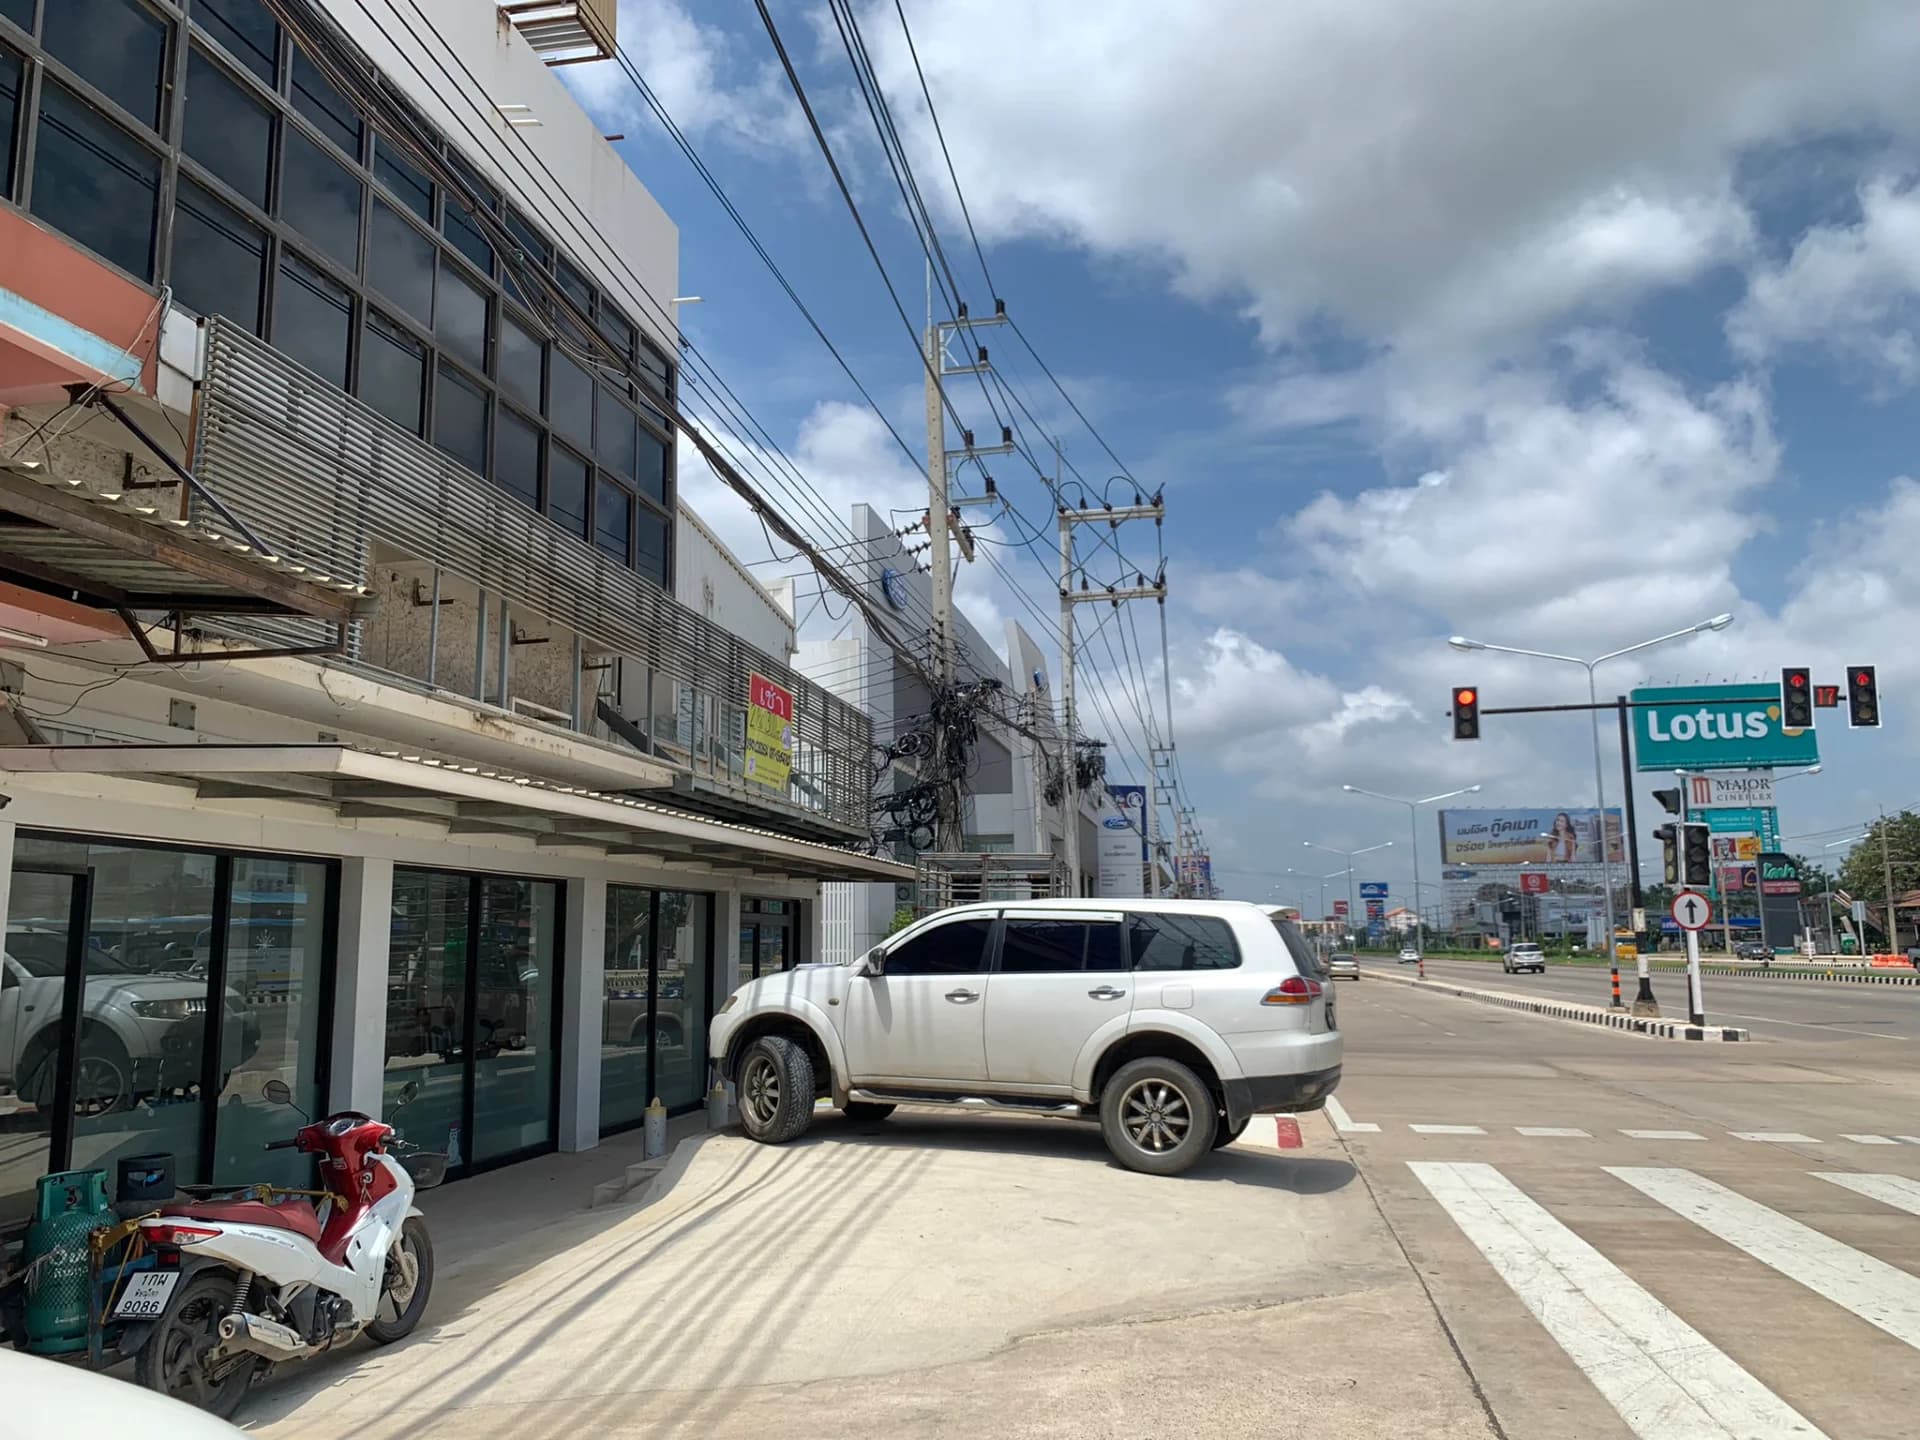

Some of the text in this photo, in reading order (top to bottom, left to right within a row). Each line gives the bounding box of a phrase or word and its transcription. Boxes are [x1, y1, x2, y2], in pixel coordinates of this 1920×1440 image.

[759, 685, 785, 716] เช่า
[1817, 688, 1836, 706] 17
[1716, 778, 1771, 793] MAJOR
[1490, 818, 1539, 838] กู๊ดเมท
[1455, 840, 1485, 853] อร่อย
[122, 1300, 160, 1313] 9086
